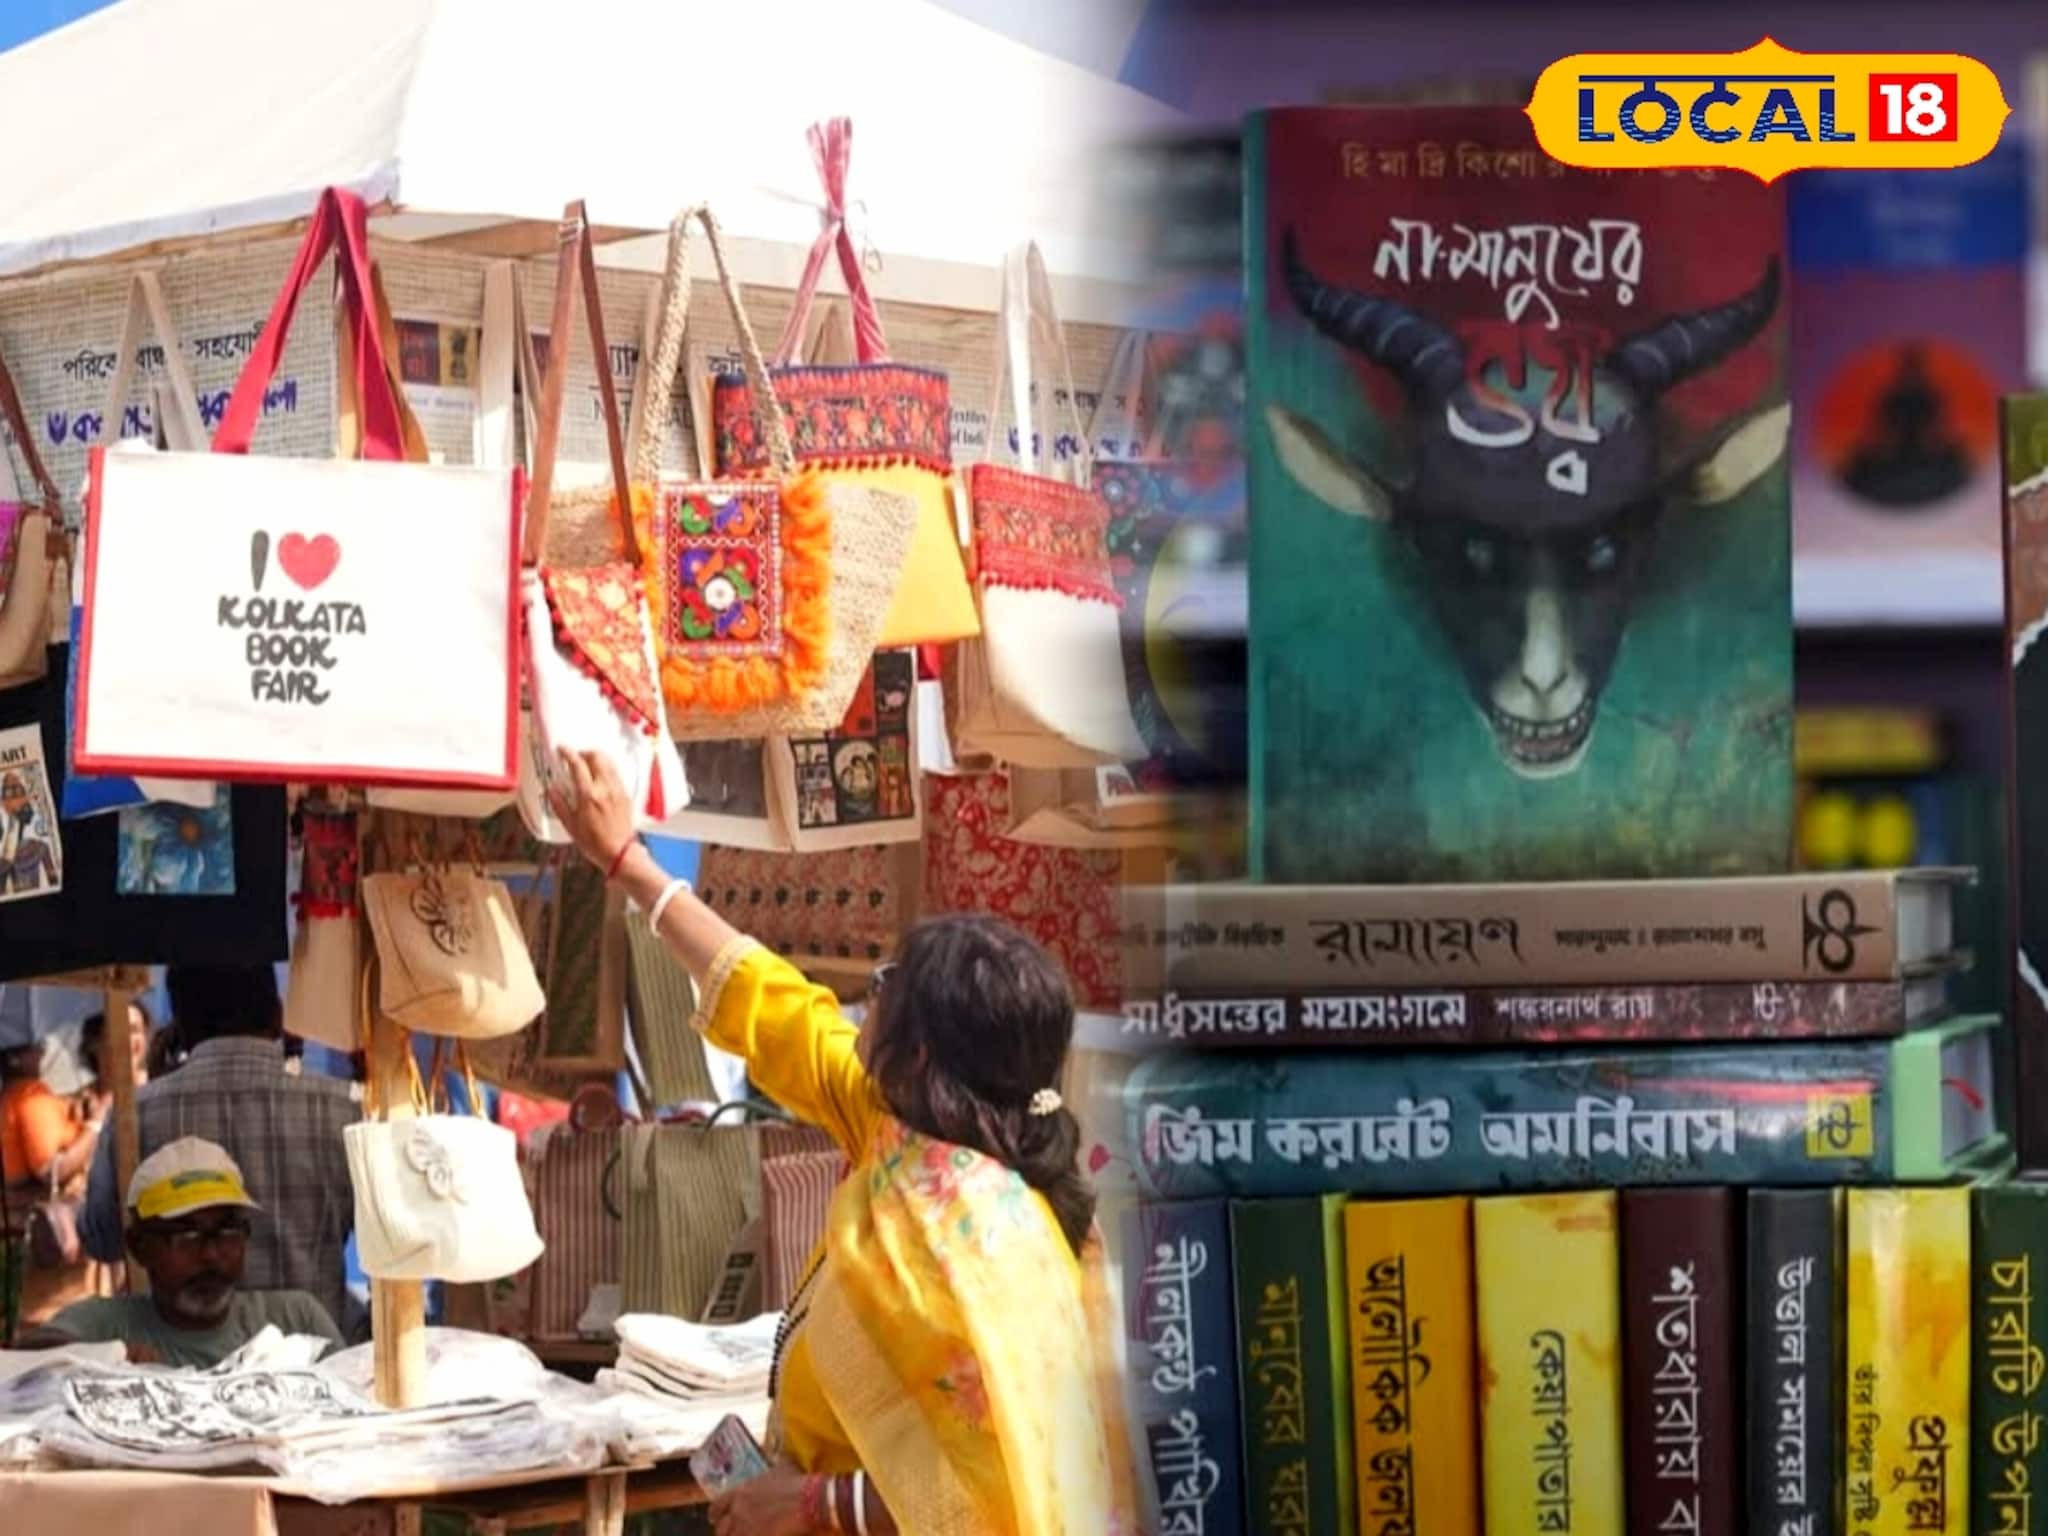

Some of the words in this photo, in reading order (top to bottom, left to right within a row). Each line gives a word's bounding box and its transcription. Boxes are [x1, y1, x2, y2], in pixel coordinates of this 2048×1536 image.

[251, 529, 270, 592] I
[218, 595, 366, 635] KOLKATA
[246, 632, 337, 670] BOOK
[252, 669, 330, 706] FAIR
[1309, 917, 1526, 965] রামায়ণ
[1146, 1102, 1256, 1167] জিম
[1480, 1095, 1736, 1159] অমনিবাস
[1145, 1235, 1218, 1393] নীলকণ্ঠ
[1360, 1251, 1433, 1434] অলৌকিক
[1775, 1256, 1815, 1364] উত্তাল
[1987, 1252, 2046, 1397] চারটি
[1651, 1260, 1702, 1484] শতধারায়
[1529, 1328, 1574, 1534] কেয়াপাতার
[1775, 1375, 1808, 1505] সময়ের
